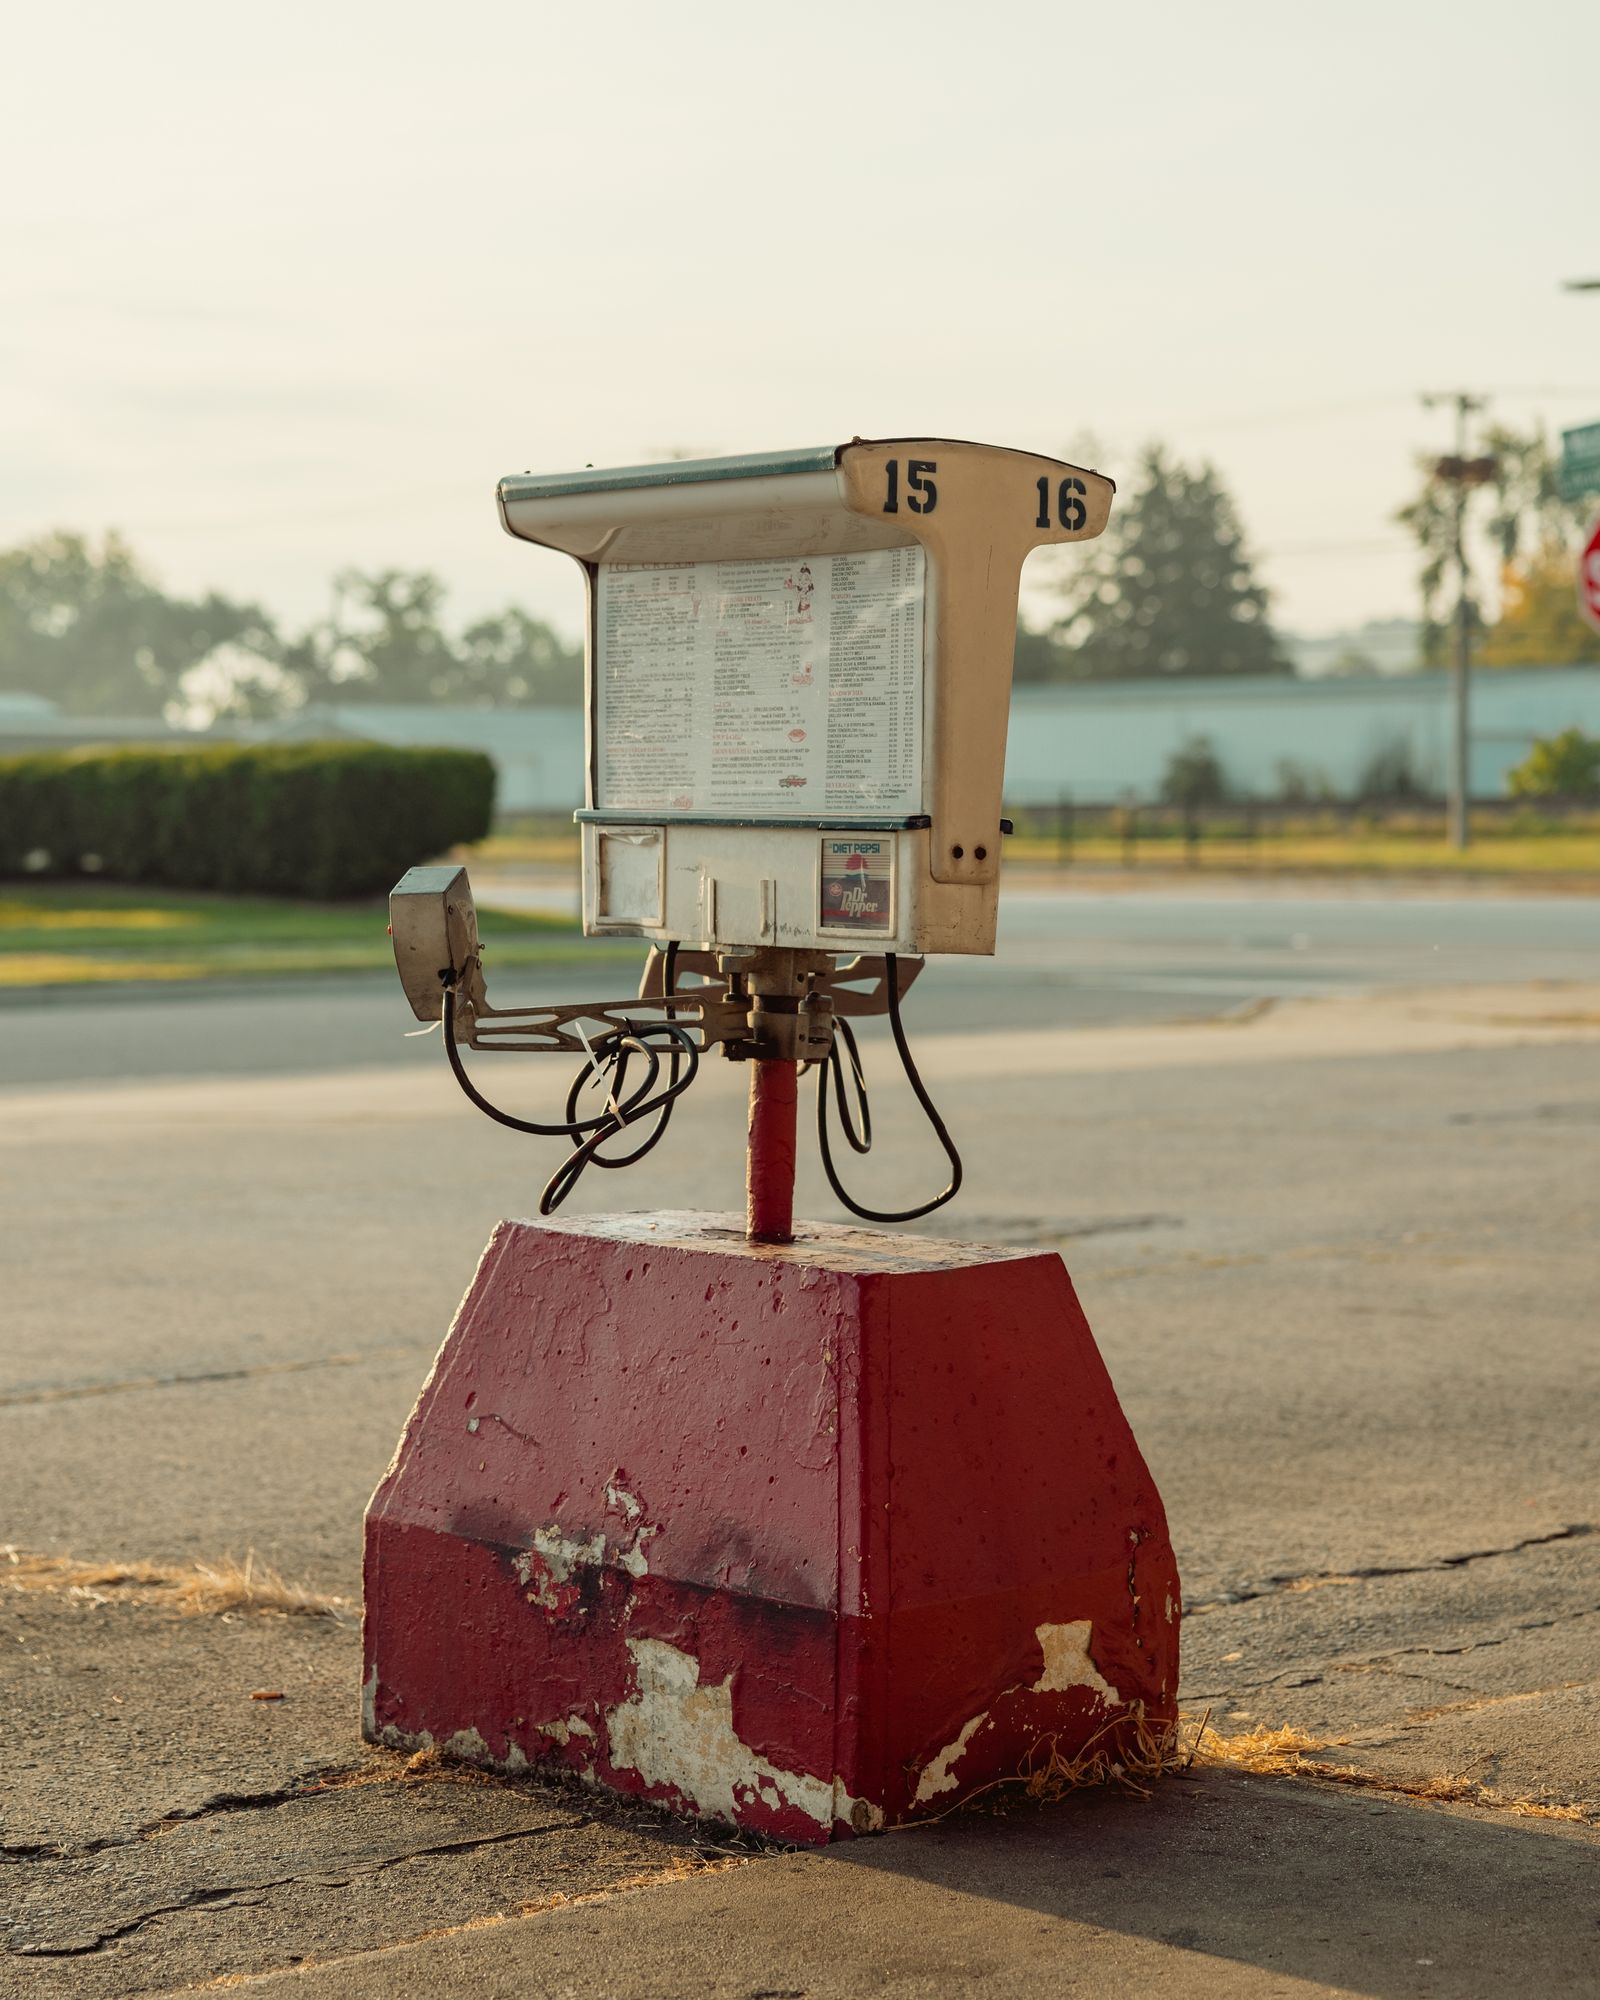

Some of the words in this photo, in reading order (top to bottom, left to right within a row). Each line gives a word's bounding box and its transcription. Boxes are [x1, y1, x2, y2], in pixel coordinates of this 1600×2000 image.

[883, 460, 937, 514] 15
[1036, 476, 1087, 531] 16
[833, 843, 852, 854] DIET
[854, 843, 880, 854] PEPSI
[840, 891, 878, 918] Pepper
[852, 887, 868, 902] Dr
